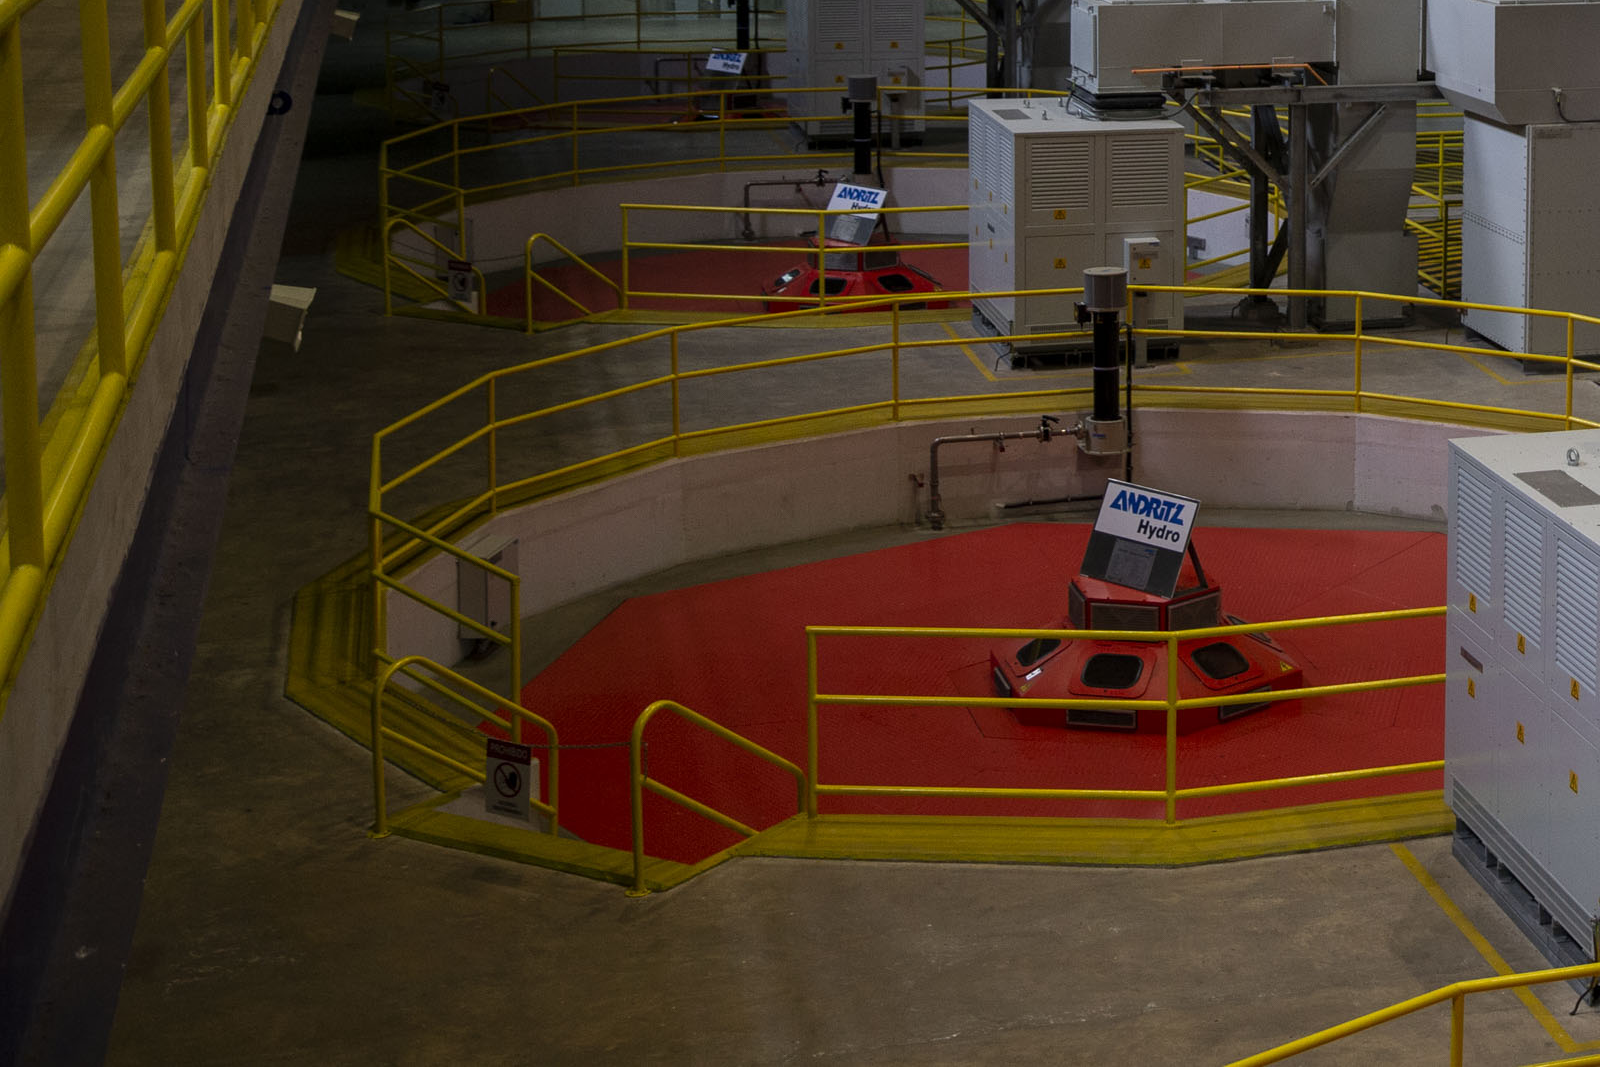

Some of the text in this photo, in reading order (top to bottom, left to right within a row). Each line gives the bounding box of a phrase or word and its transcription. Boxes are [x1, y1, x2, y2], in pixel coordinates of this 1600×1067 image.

[837, 187, 879, 204] ANDRITZ
[1110, 490, 1185, 526] ANDRITZ
[1137, 519, 1181, 542] Hydro
